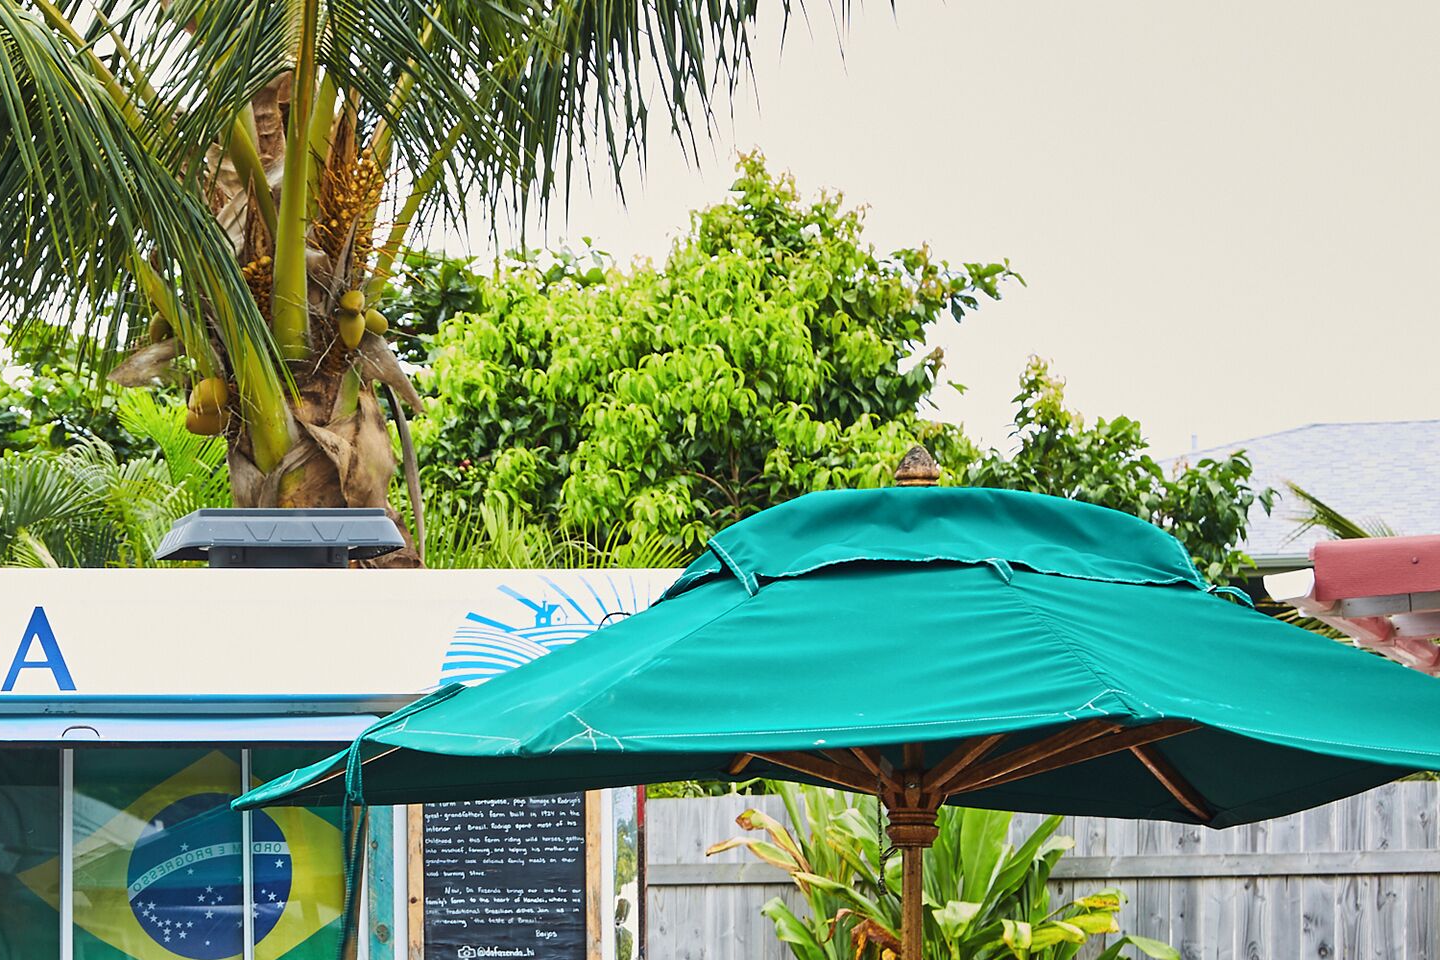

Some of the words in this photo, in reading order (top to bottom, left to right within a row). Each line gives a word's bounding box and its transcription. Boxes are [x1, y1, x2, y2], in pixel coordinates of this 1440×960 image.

[491, 822, 512, 833] Rodrigo
[555, 820, 563, 828] of
[477, 946, 535, 957] @dafazenda_hi
